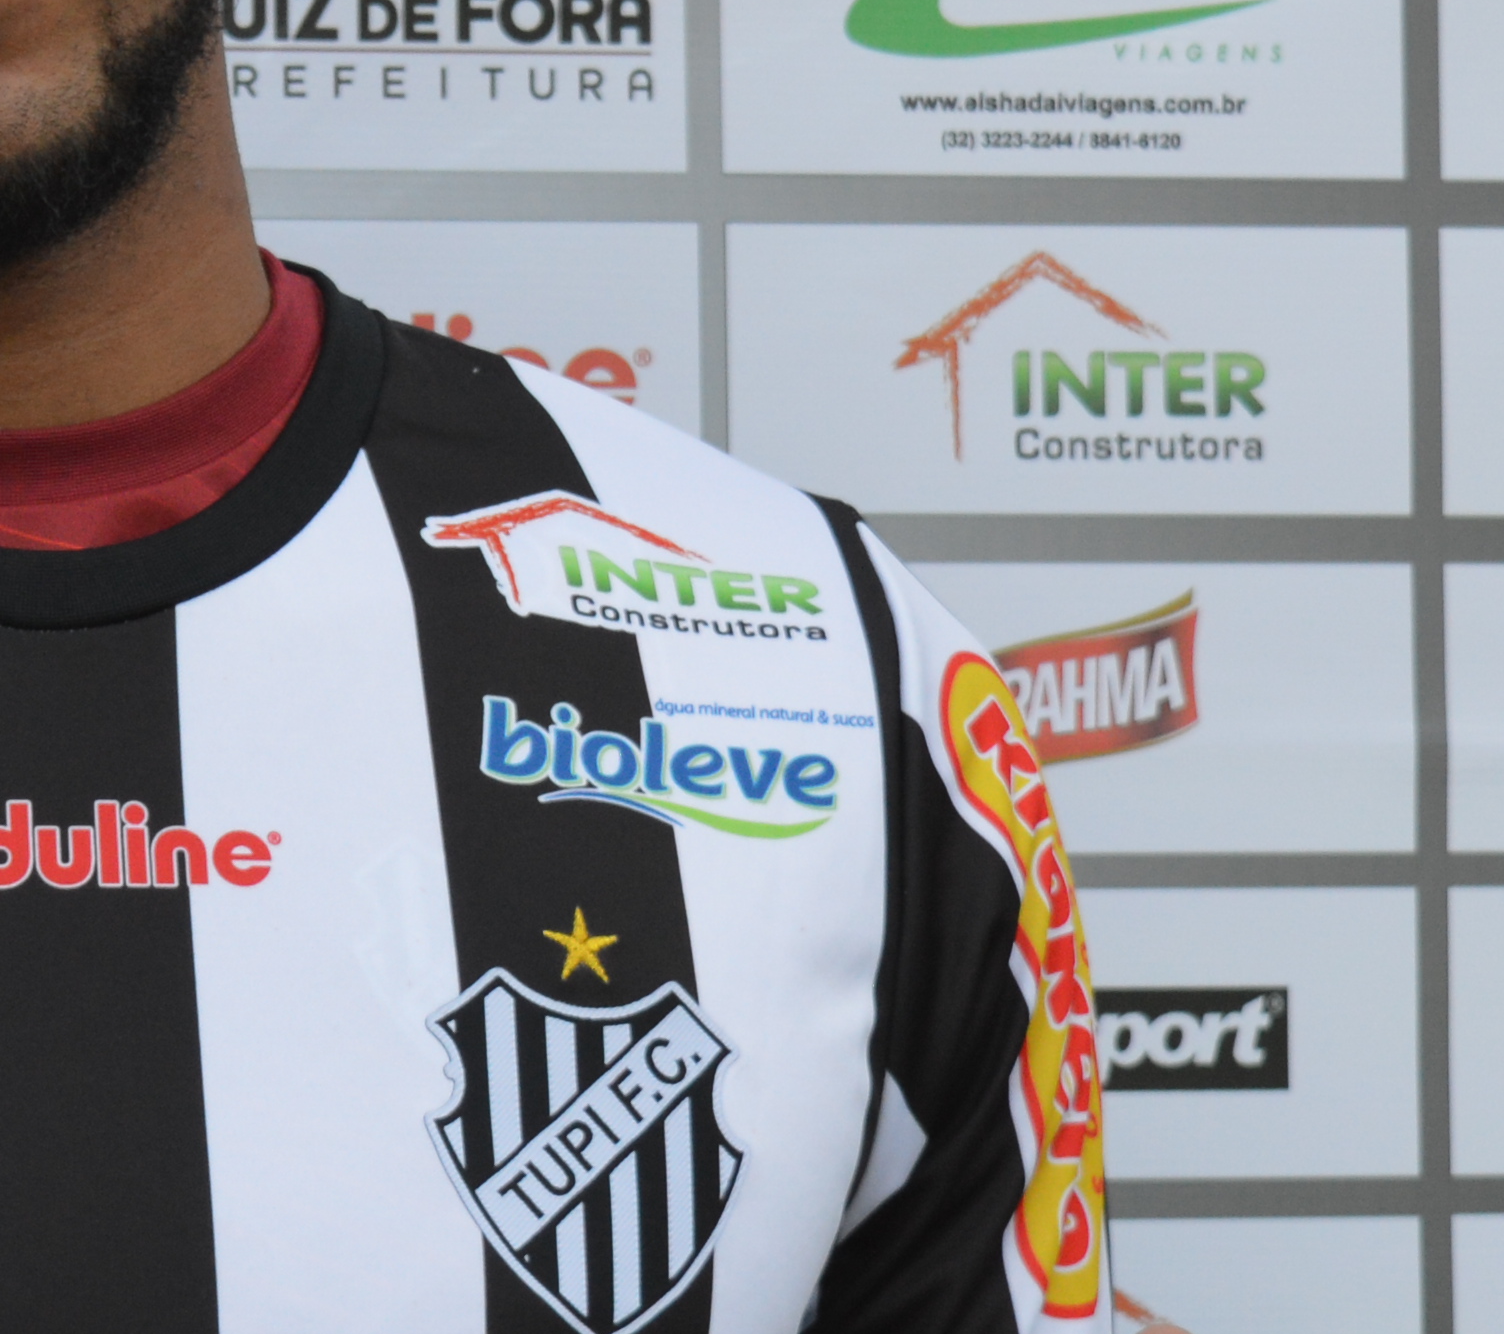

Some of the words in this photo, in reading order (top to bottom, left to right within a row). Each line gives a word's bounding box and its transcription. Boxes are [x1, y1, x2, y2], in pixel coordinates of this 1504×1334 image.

[1114, 43, 1284, 64] VIAGENS
[232, 65, 655, 101] REFEITURA
[1013, 351, 1265, 418] INTER
[1014, 427, 1264, 461] Construtora
[559, 545, 823, 615] INTER
[571, 594, 827, 641] Construtora
[698, 701, 756, 720] mineral
[759, 705, 814, 724] natural
[817, 710, 829, 725] &
[833, 713, 875, 728] sucos
[486, 699, 837, 808] bioleve
[498, 1104, 620, 1219] TUPI
[608, 1037, 701, 1123] F.C.
